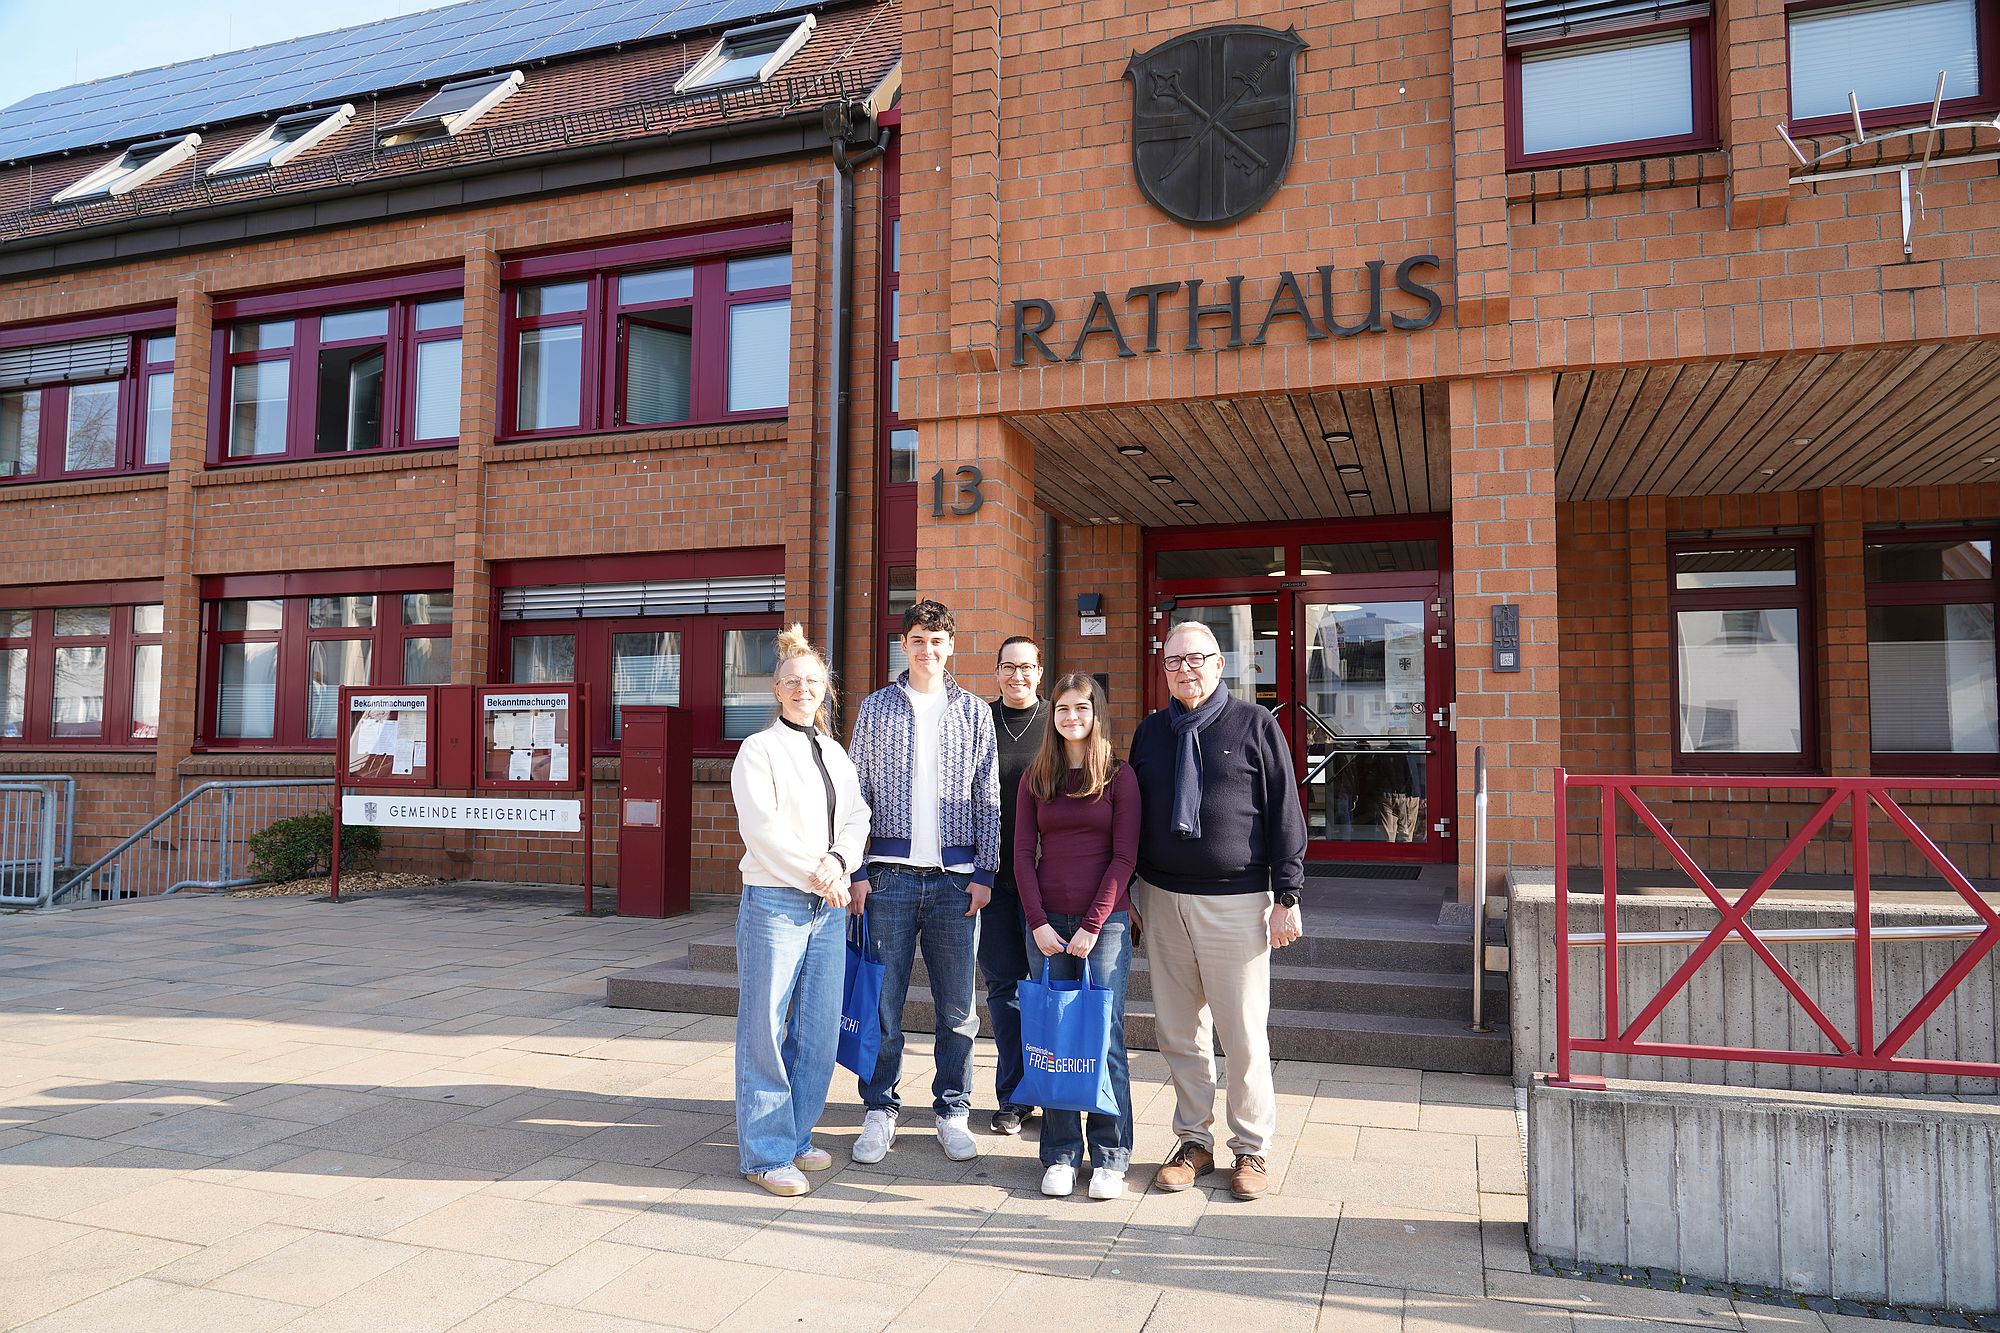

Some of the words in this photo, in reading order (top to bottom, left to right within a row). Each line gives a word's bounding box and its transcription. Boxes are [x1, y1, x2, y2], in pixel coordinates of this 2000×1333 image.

[1011, 255, 1442, 367] RATHAUS
[931, 465, 983, 517] 13
[353, 699, 425, 709] Bekanntmachungen
[487, 698, 566, 707] Bekanntmachungen
[389, 805, 457, 819] GEMEINDE
[465, 807, 556, 822] FREIGERICHT
